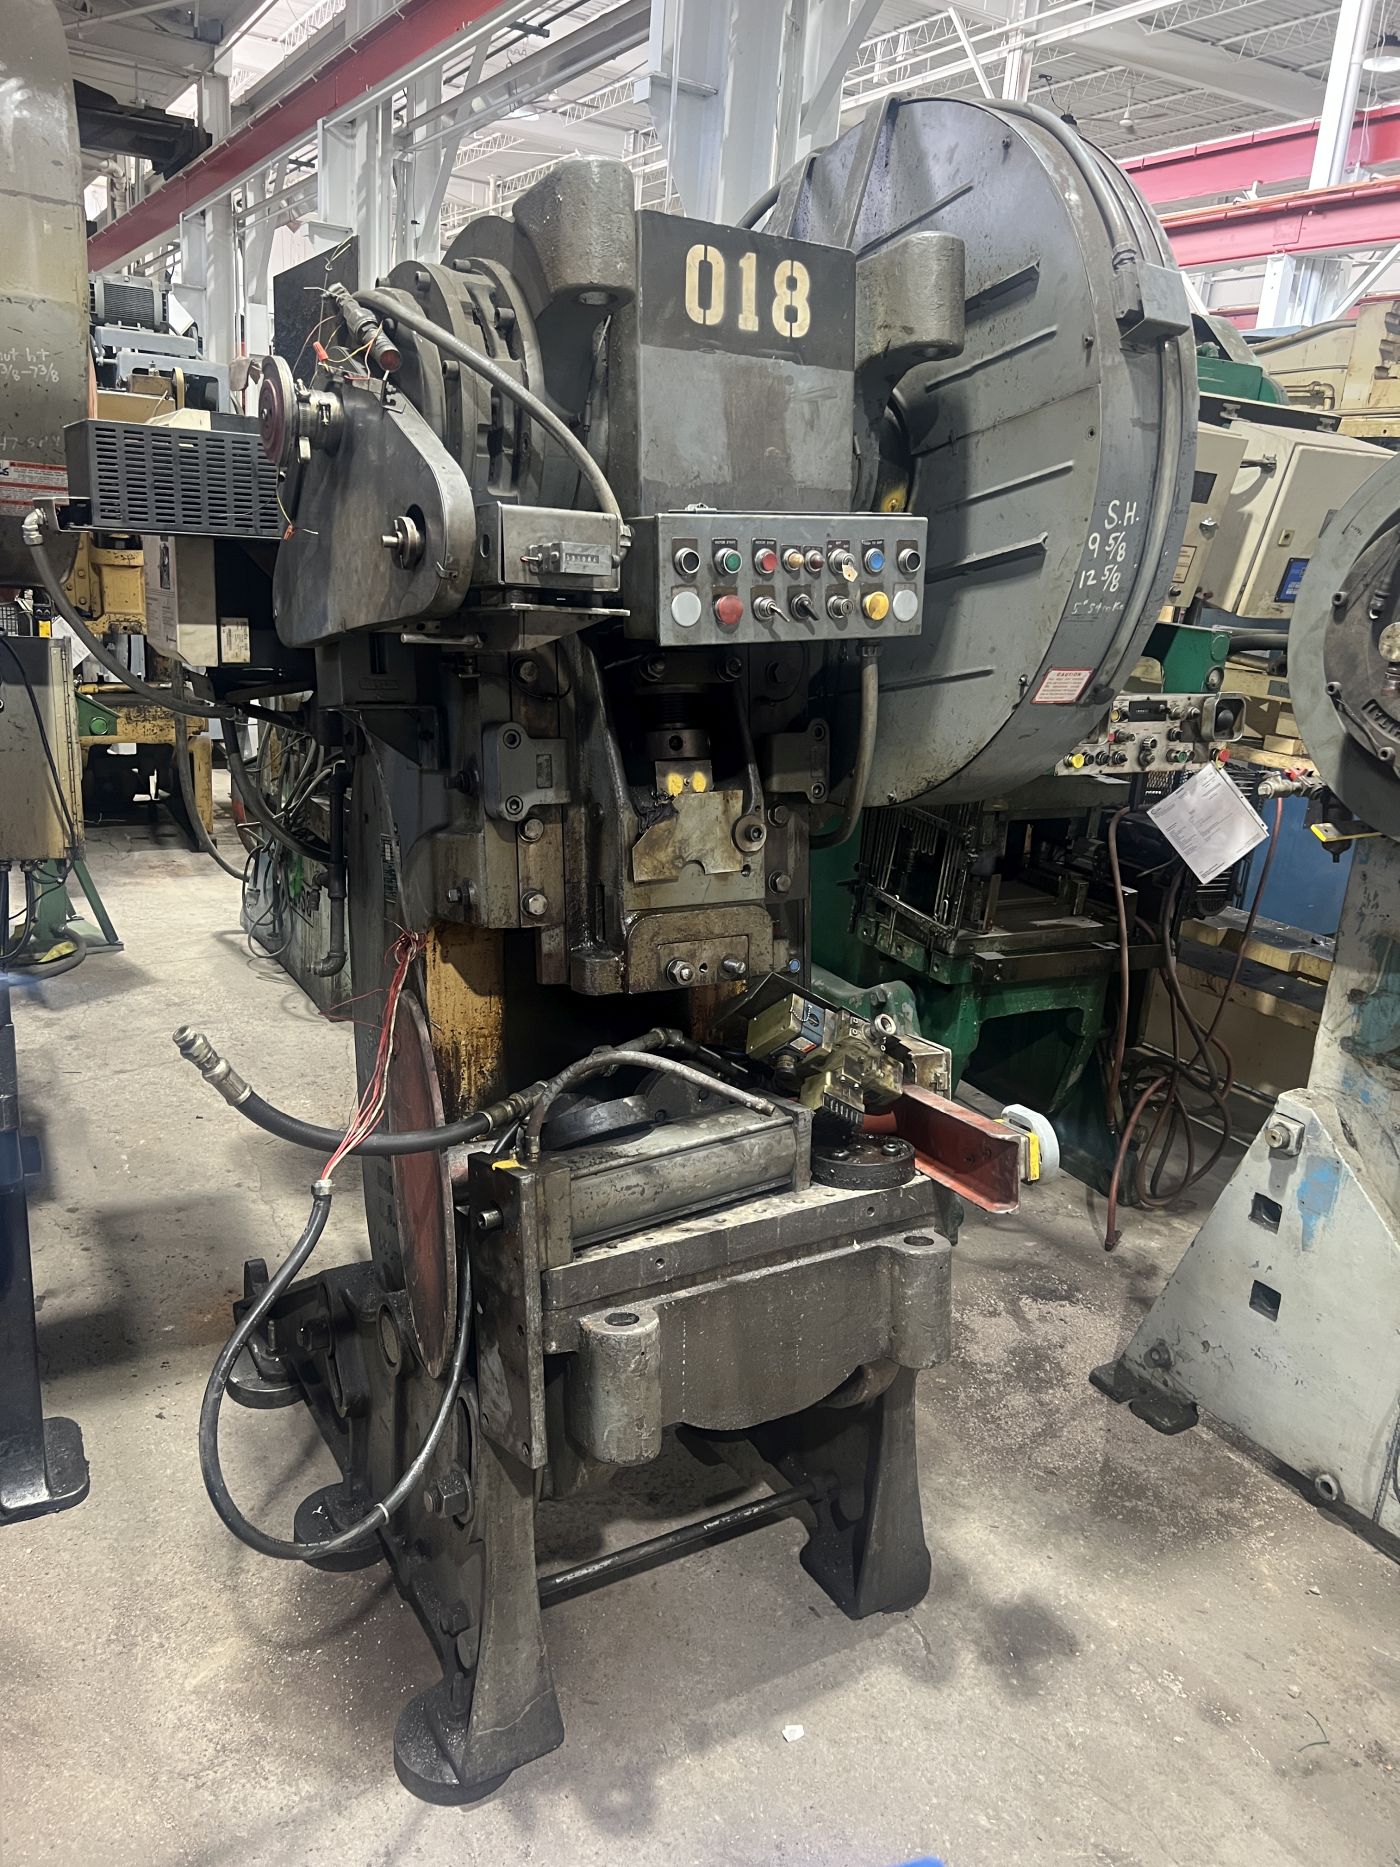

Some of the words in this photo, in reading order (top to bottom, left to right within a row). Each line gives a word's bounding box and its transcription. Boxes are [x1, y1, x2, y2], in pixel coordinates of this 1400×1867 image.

[685, 243, 811, 338] 018
[1104, 499, 1140, 529] S.H.
[1088, 532, 1100, 558] 9
[1104, 531, 1126, 562] 5/8
[1078, 570, 1097, 589] 12
[1101, 564, 1121, 592] 5/8
